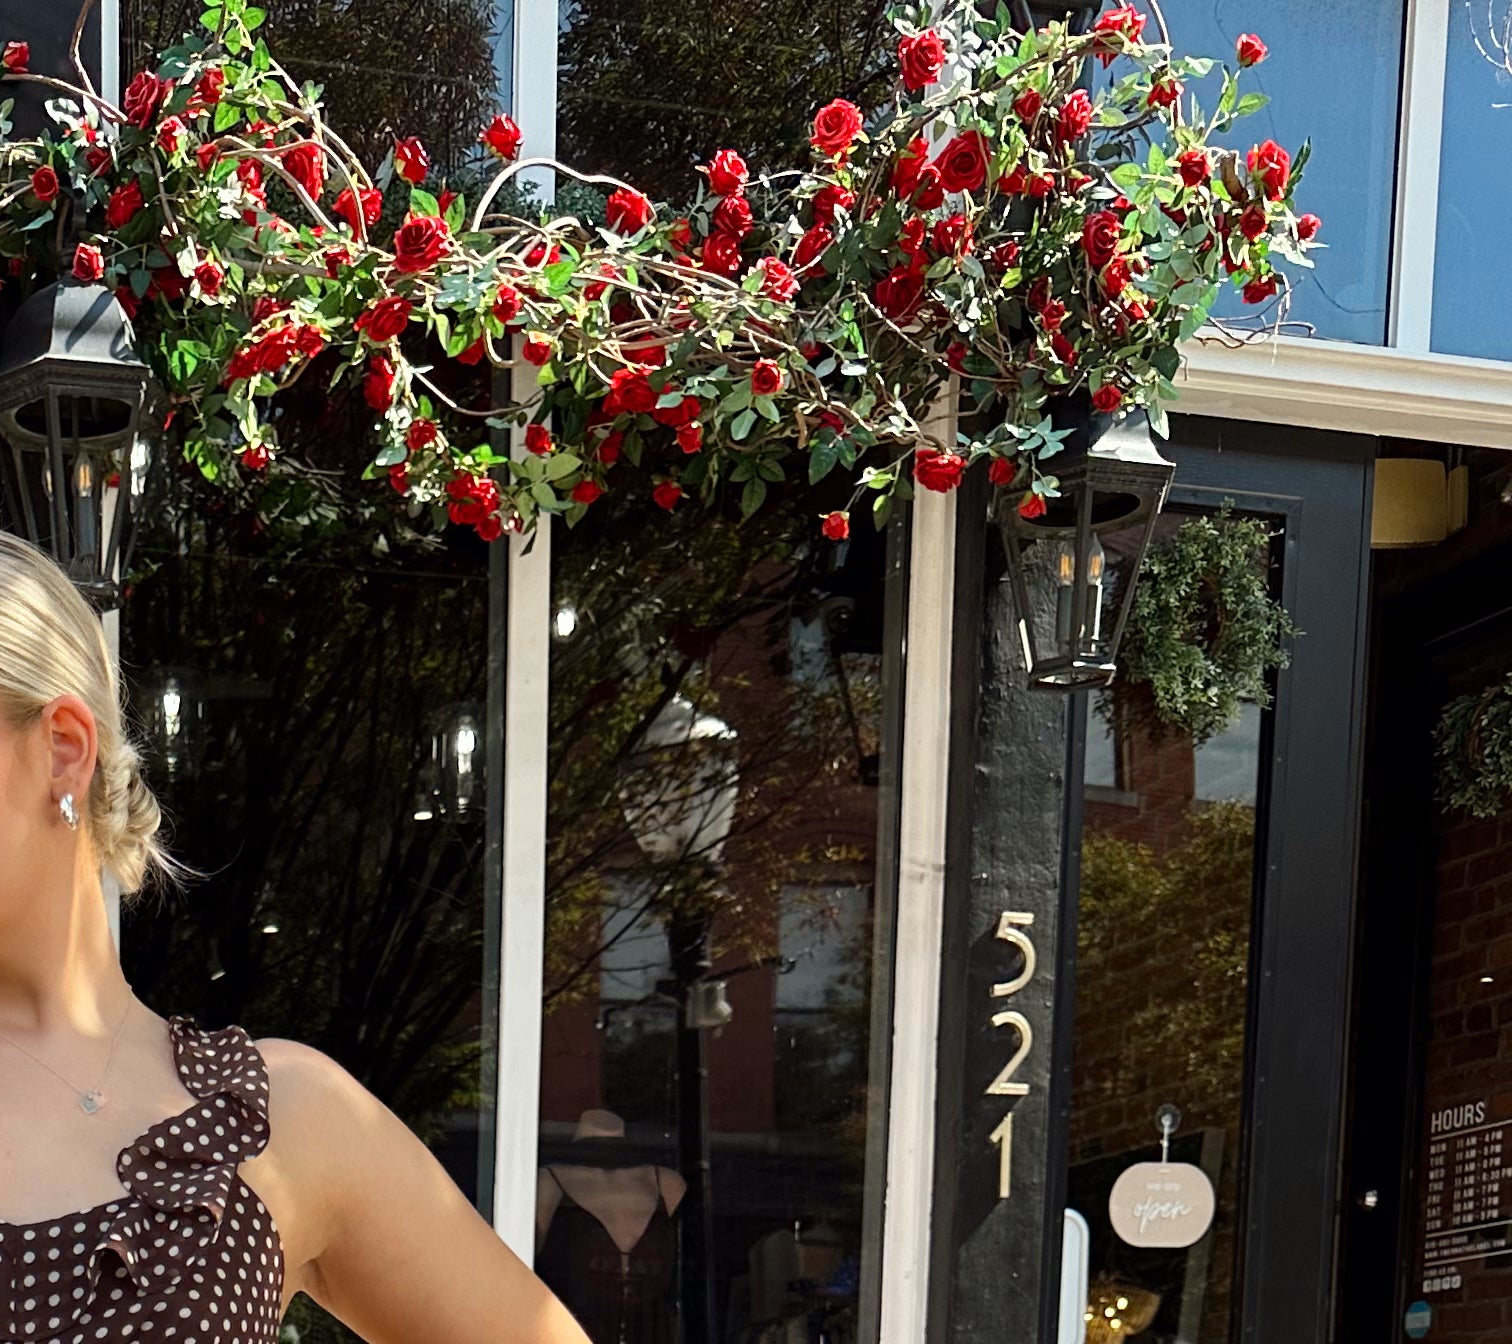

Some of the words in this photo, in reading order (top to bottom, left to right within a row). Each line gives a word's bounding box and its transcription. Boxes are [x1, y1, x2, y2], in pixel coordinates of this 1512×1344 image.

[986, 911, 1036, 1198] 521
[1431, 1101, 1485, 1134] HOURS
[1466, 1136, 1477, 1147] AM
[1491, 1130, 1503, 1141] PM
[1465, 1149, 1476, 1159] AM
[1490, 1144, 1502, 1154] PM
[1464, 1162, 1475, 1173] AM
[1489, 1157, 1501, 1167] PM
[1464, 1174, 1475, 1185] AM
[1502, 1167, 1512, 1178] PM
[1463, 1188, 1474, 1198] AM
[1488, 1183, 1499, 1193] PM
[1463, 1200, 1474, 1210] AM
[1487, 1195, 1499, 1206] PM
[1133, 1194, 1192, 1234] open
[1462, 1213, 1473, 1223] AM
[1487, 1208, 1499, 1219] PM
